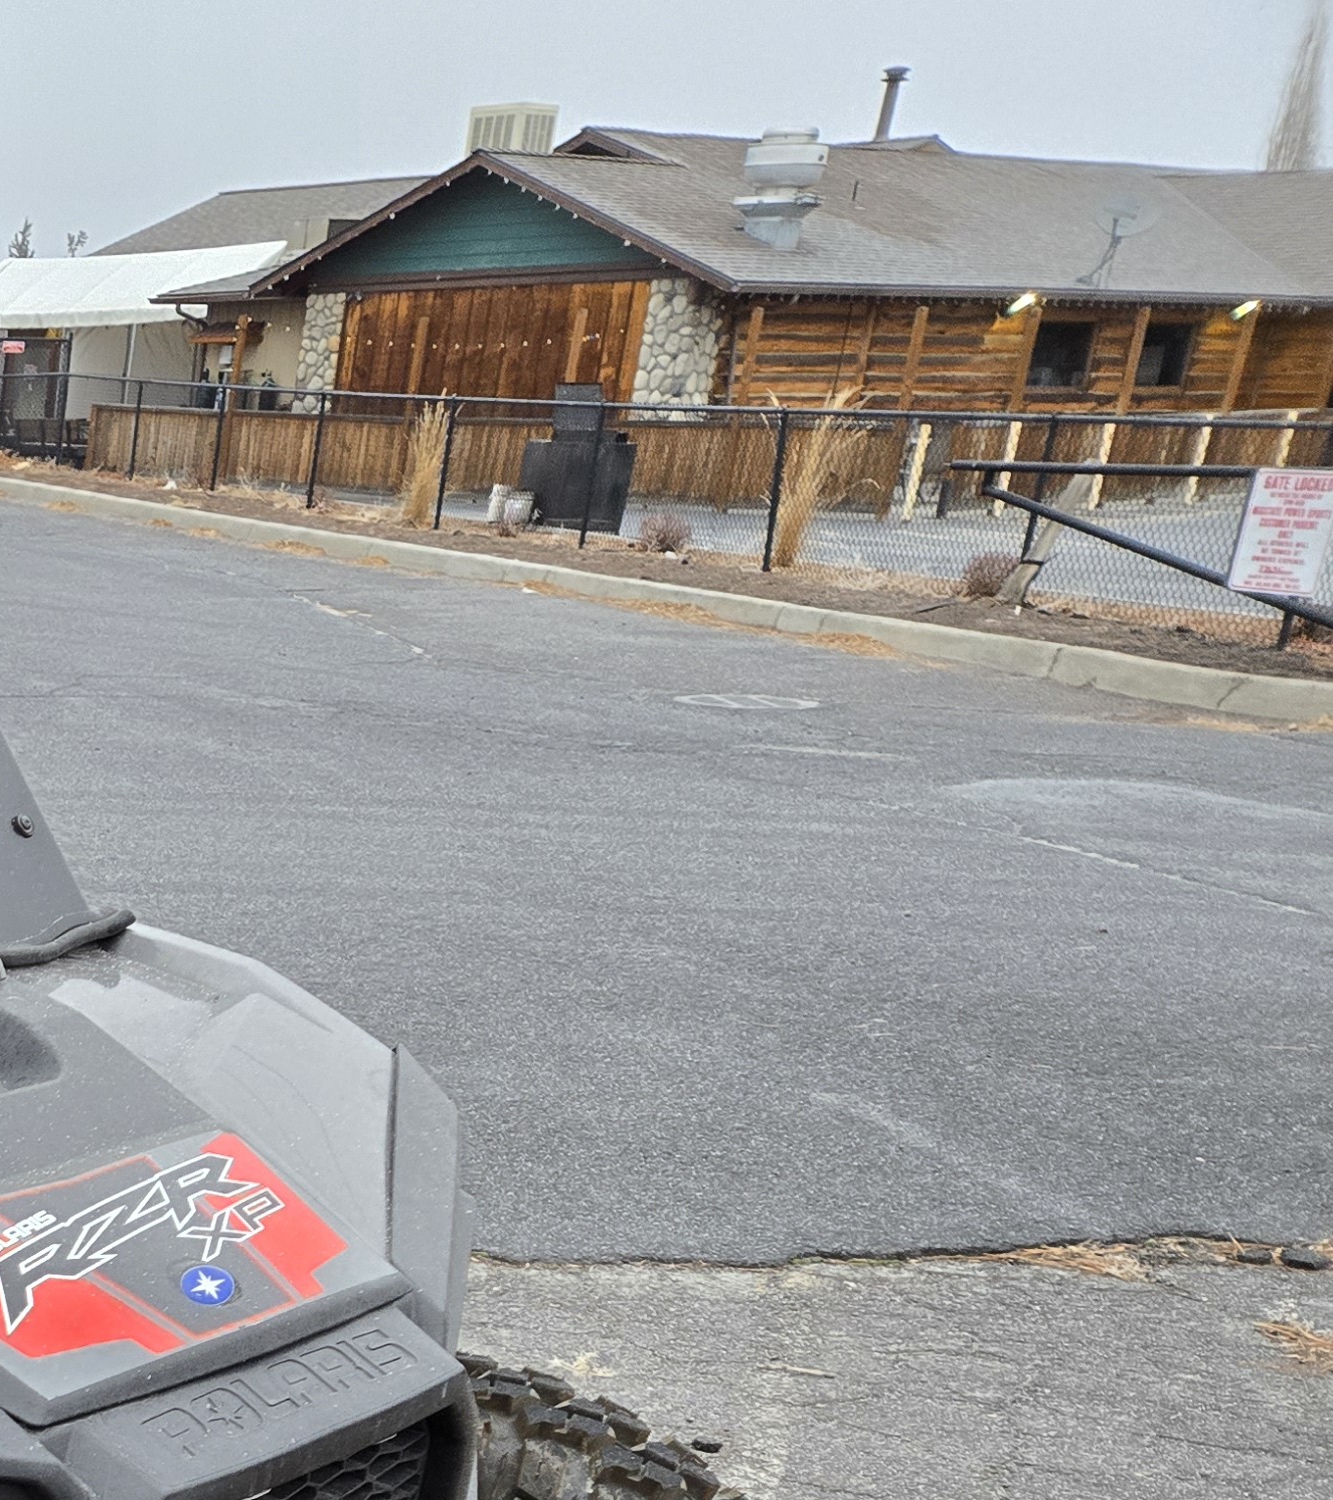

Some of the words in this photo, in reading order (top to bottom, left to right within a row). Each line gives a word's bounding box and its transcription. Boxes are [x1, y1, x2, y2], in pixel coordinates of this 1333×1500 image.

[1264, 475, 1291, 490] GATE
[176, 1187, 286, 1262] XP
[141, 1326, 420, 1458] POLARIS
